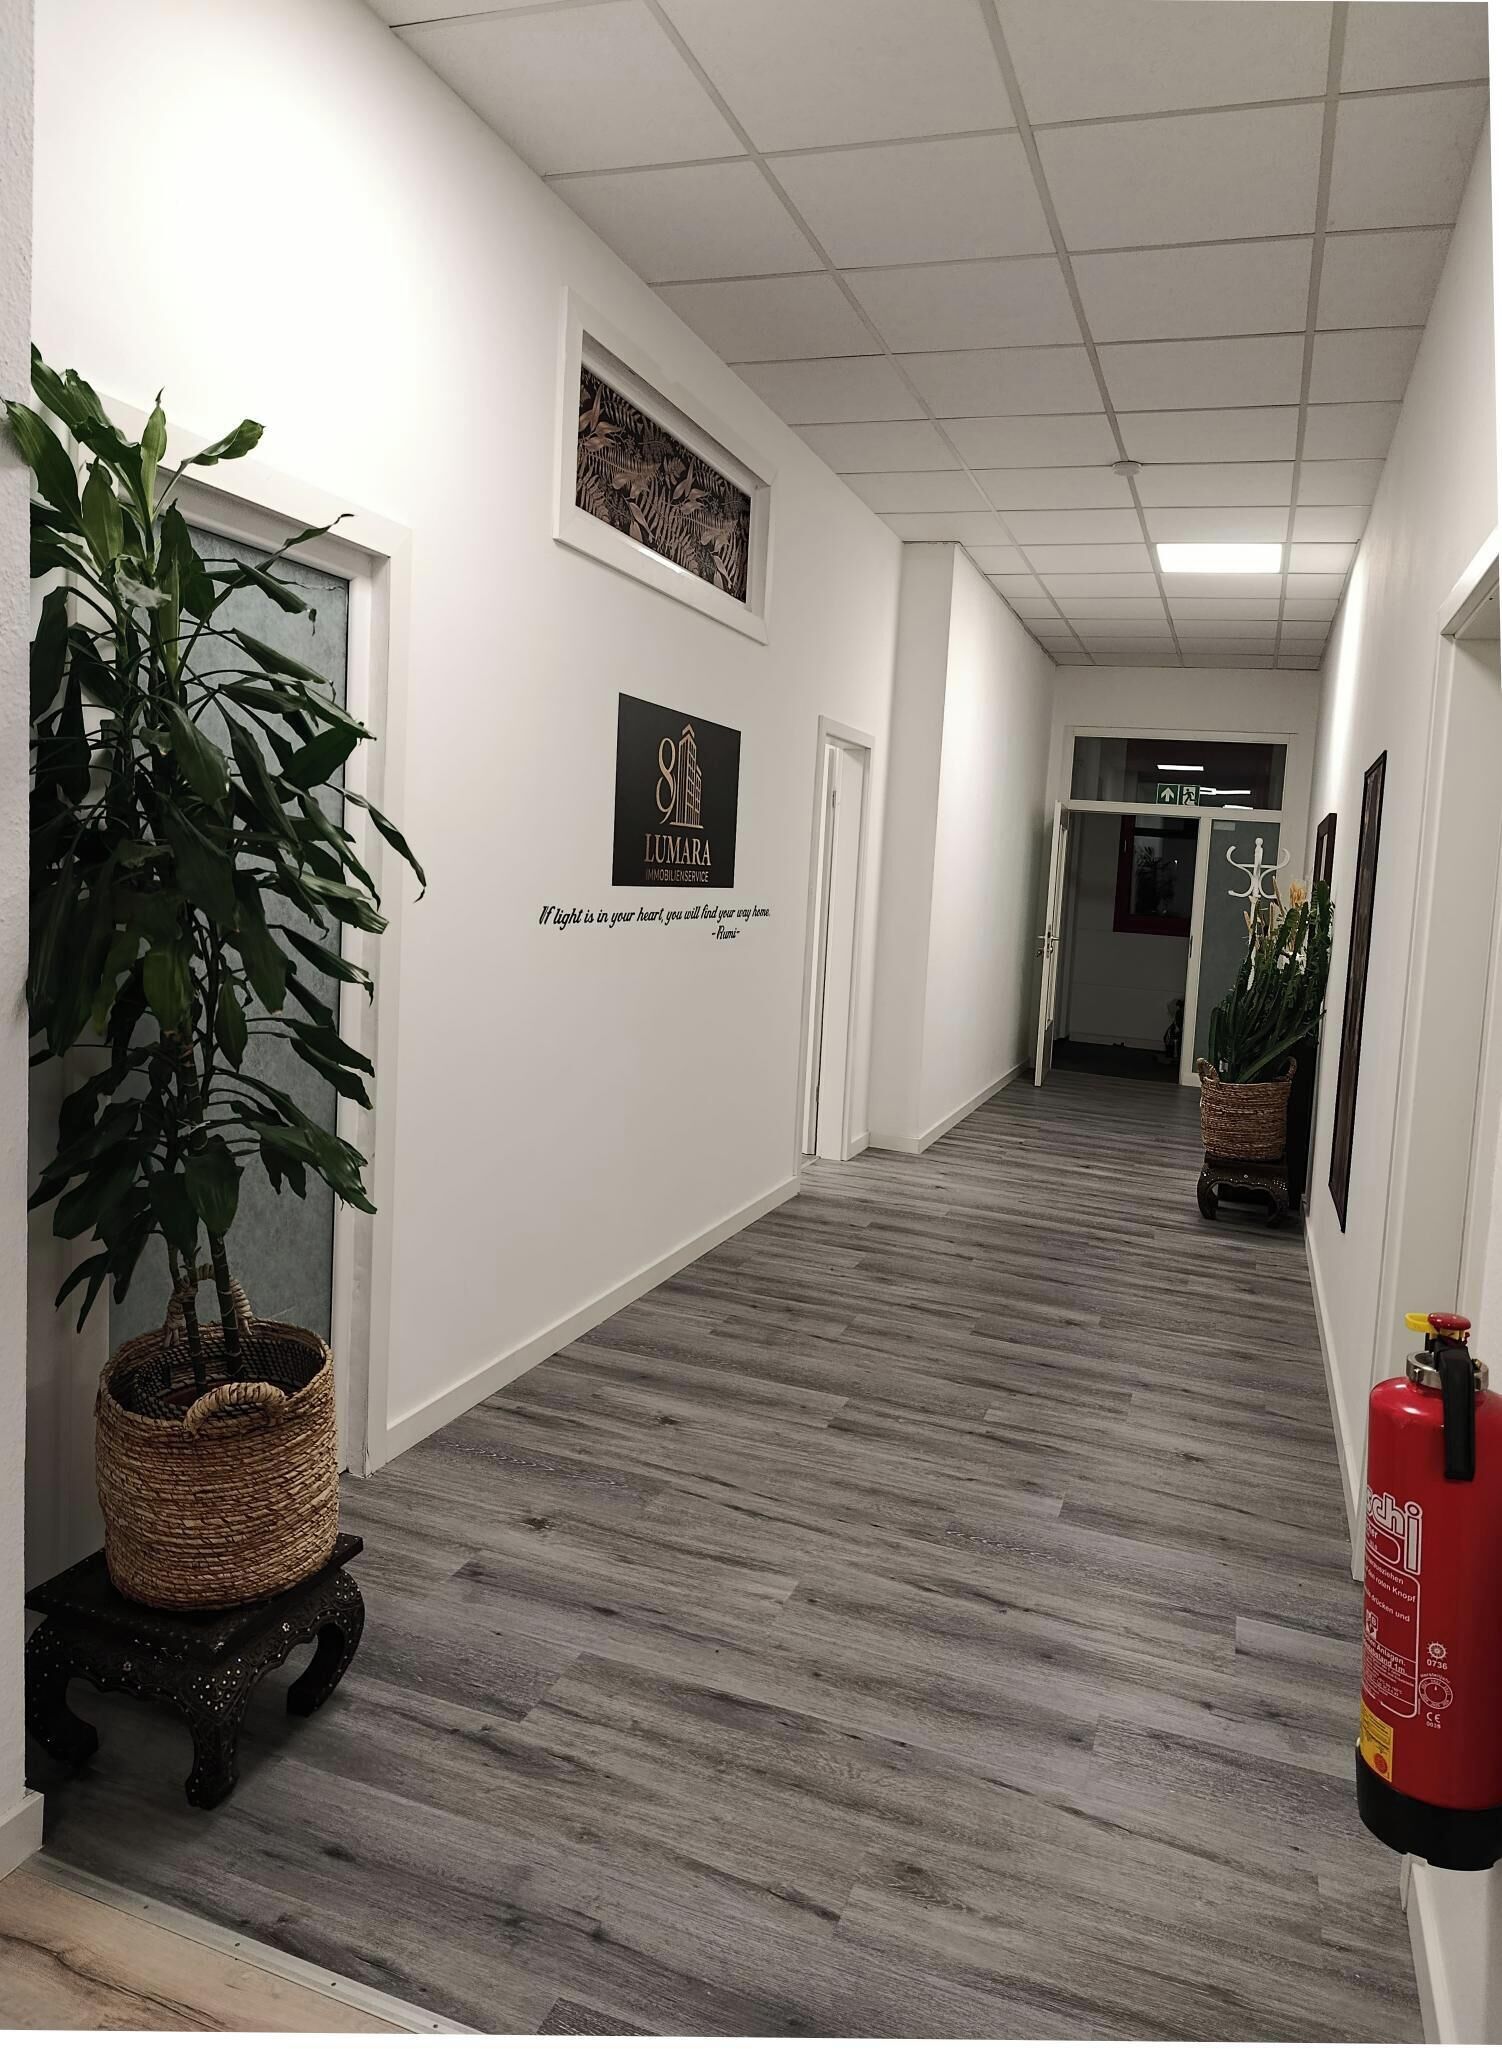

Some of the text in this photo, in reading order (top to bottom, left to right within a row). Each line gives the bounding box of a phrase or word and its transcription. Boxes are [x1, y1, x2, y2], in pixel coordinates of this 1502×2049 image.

[644, 833, 711, 866] LUMARA
[645, 868, 709, 883] IMMOBILIENSERVICE
[539, 905, 556, 925] If
[553, 908, 583, 930] light
[584, 909, 594, 923] is
[597, 909, 608, 923] in
[609, 912, 635, 928] your
[637, 907, 664, 923] heart,
[665, 911, 683, 926] you
[684, 906, 701, 920] will
[701, 904, 719, 919] find
[717, 909, 735, 923] your
[737, 909, 751, 922] way
[1393, 1586, 1416, 1603] Knopf
[1395, 1610, 1410, 1622] und
[1427, 1658, 1448, 1671] 0736
